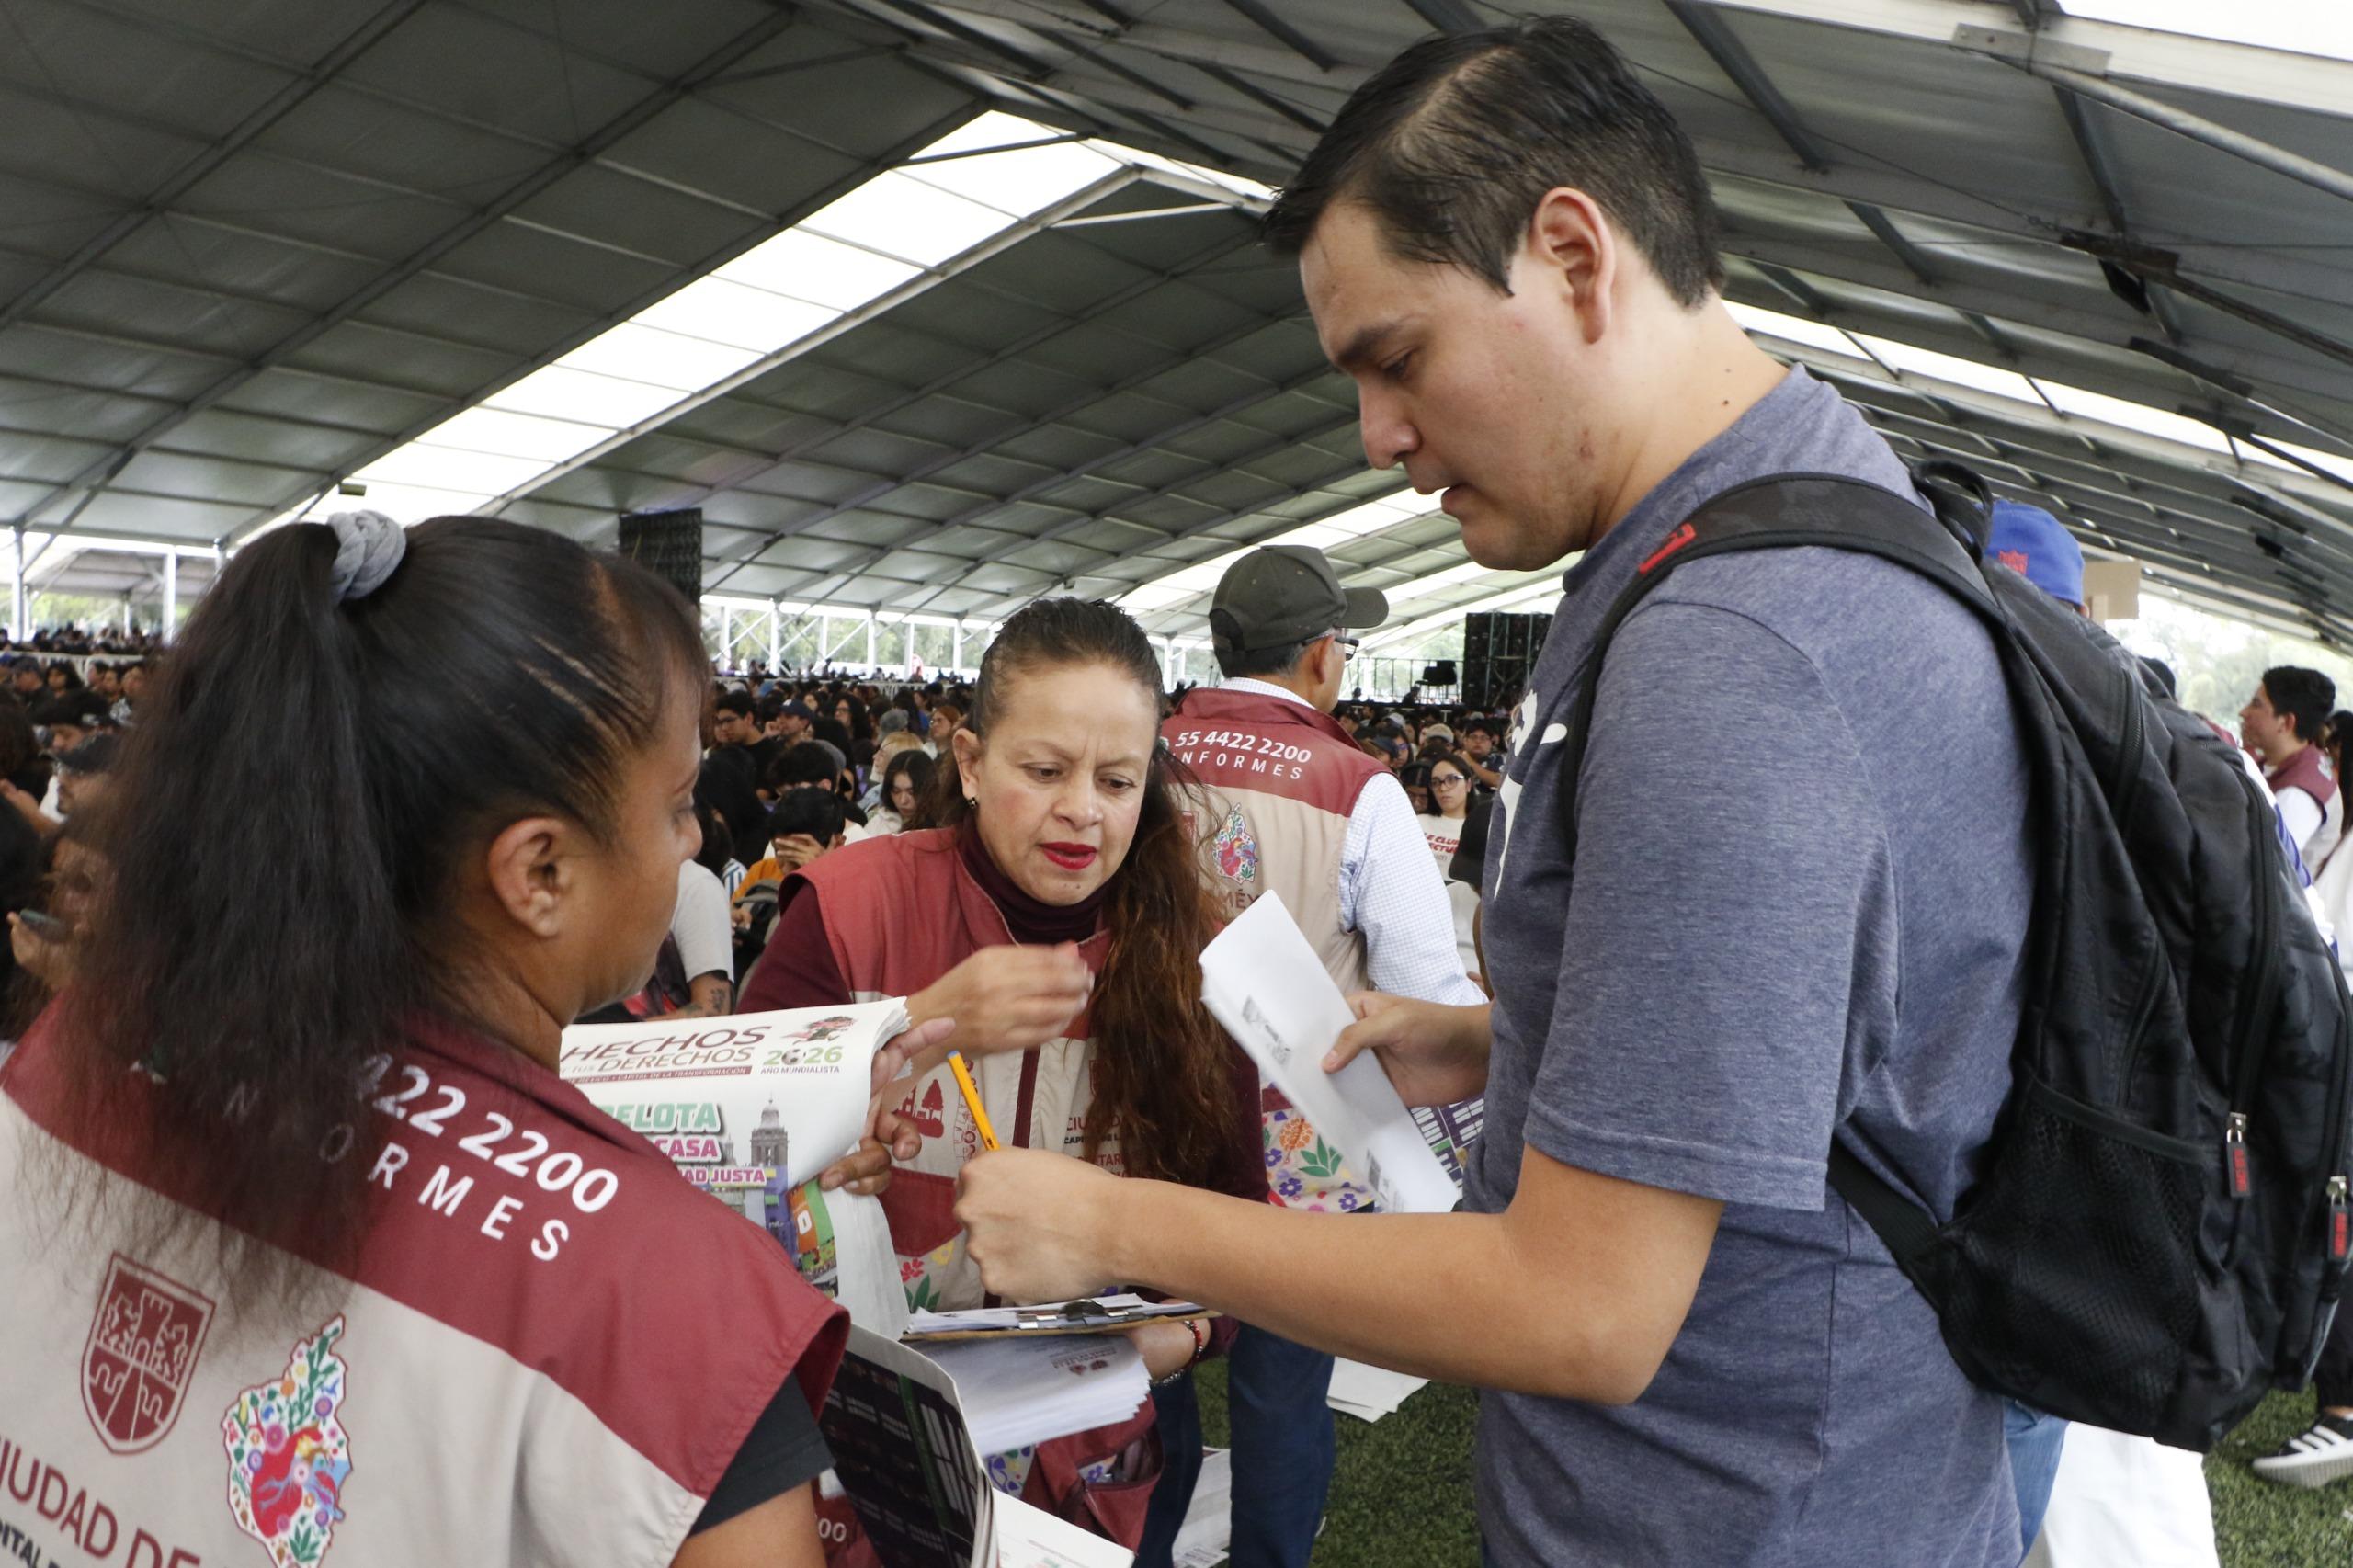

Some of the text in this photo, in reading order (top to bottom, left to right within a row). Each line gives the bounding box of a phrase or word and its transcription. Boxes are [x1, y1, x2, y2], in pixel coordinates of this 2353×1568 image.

[1175, 731, 1312, 763] 55 4422 2200
[1173, 751, 1302, 779] NFORMES
[561, 1026, 771, 1062] HECHOS
[598, 1046, 755, 1072] DERECHOS
[780, 1065, 840, 1074] MUNDIALISTA
[458, 1112, 619, 1213] 2200
[710, 1168, 766, 1183] JUSTA
[0, 1436, 118, 1558] IUDAD
